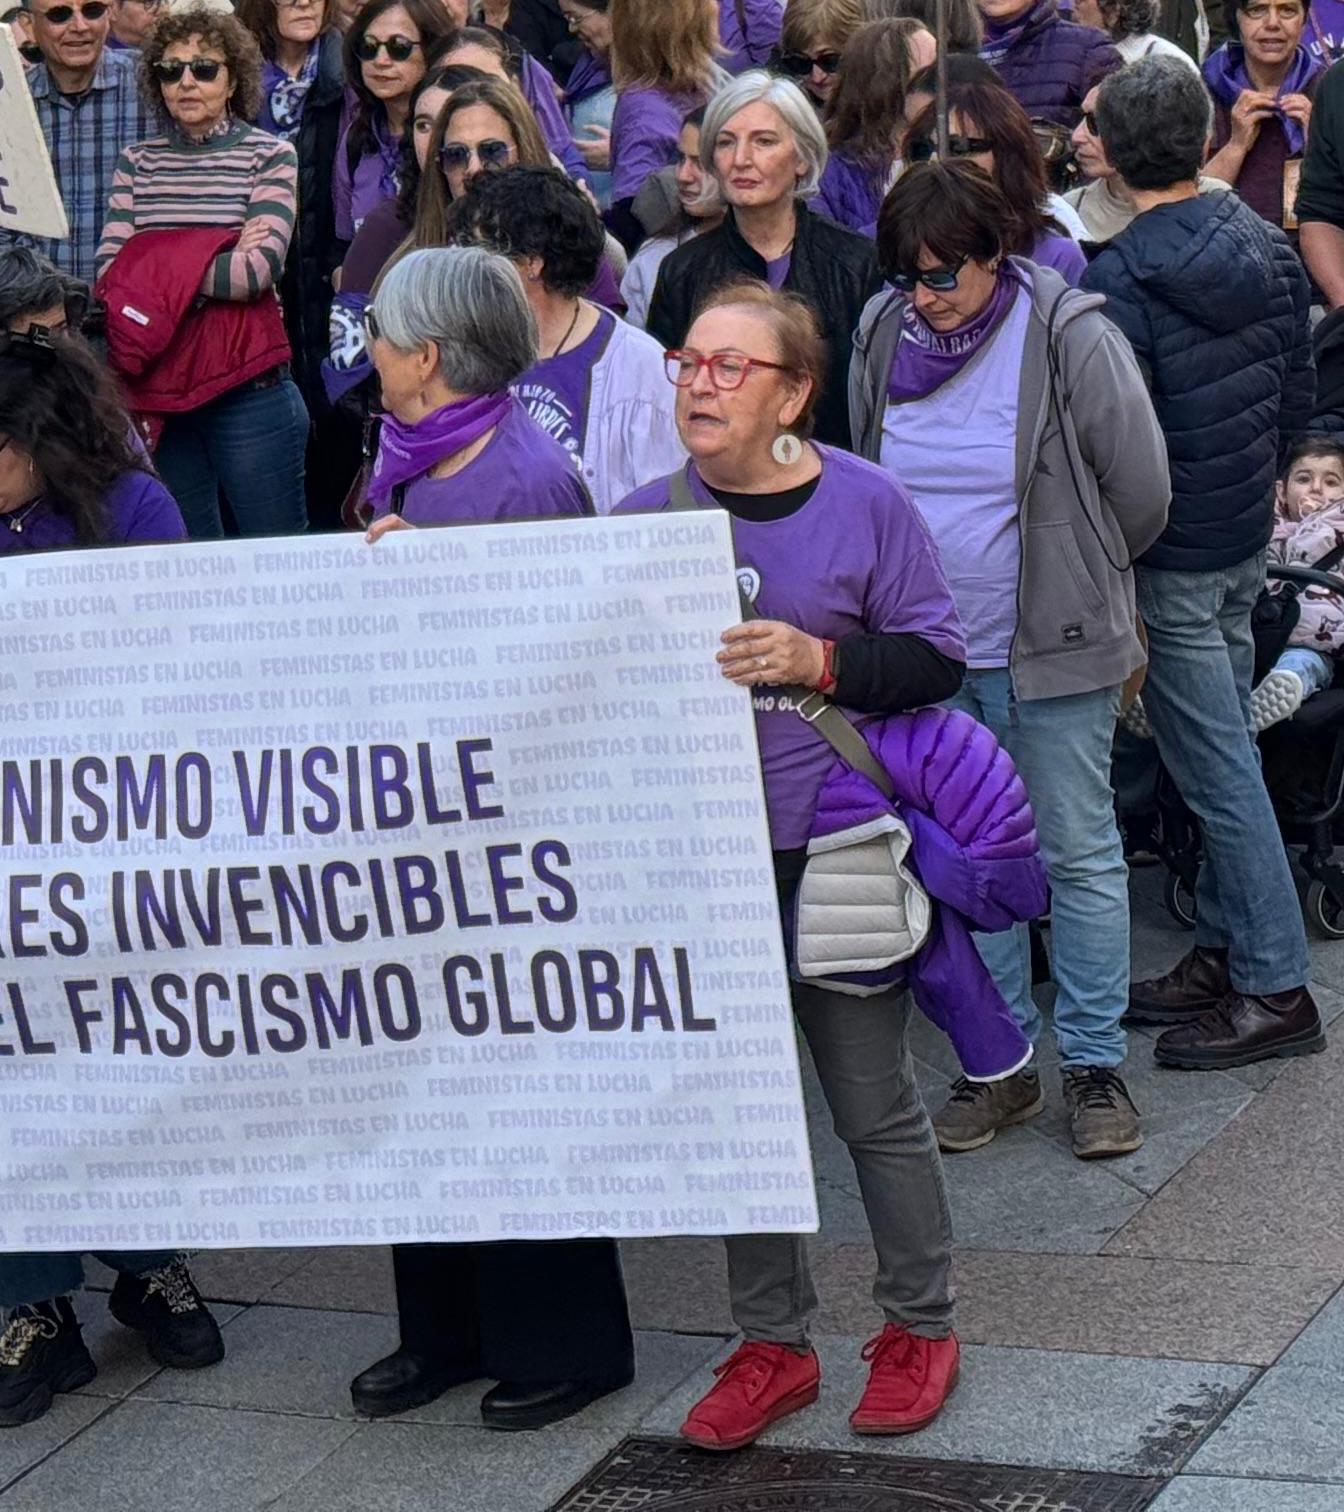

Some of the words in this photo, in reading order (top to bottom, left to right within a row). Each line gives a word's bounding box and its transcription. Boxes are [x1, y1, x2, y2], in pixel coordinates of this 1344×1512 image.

[254, 542, 370, 575] FEMINISTAS
[368, 541, 400, 570] EN
[400, 542, 470, 568] LUCHA
[487, 531, 610, 560] FEMINISTAS
[613, 529, 644, 552] EN
[646, 524, 718, 552] LUCHA
[26, 562, 141, 589] FEMINISTAS
[145, 560, 171, 582] EN
[174, 556, 238, 582] LUCHA
[361, 572, 482, 601] FEMINISTAS
[484, 570, 514, 594] EN
[518, 566, 585, 592] LUCHA
[603, 557, 729, 585] FEMINISTAS
[19, 598, 49, 621] EN
[54, 595, 119, 619] LUCHA
[418, 605, 540, 633] FEMINISTAS
[544, 604, 573, 626] EN
[578, 595, 649, 625] LUCHA
[81, 630, 109, 651] EN
[112, 625, 174, 650] LUCHA
[260, 653, 376, 679] FEMINISTAS
[380, 650, 409, 673] EN
[413, 647, 479, 671] LUCHA
[508, 736, 638, 768] FEMINISTAS
[642, 735, 671, 757] EN
[675, 733, 745, 758] LUCHA
[232, 738, 505, 837] VISIBLE
[112, 839, 579, 954] INVENCIBLES
[65, 962, 422, 1060] FASCISMO
[442, 946, 718, 1037] GLOBAL
[304, 1043, 433, 1078] FEMINISTAS
[437, 1046, 467, 1067] EN
[471, 1039, 539, 1067] LUCHA
[554, 1040, 678, 1063] FEMINISTAS
[682, 1040, 712, 1062] EN
[712, 1033, 785, 1061] LUCHA
[428, 1074, 550, 1099] FEMINISTAS
[554, 1074, 583, 1095] EN
[588, 1069, 653, 1096] LUCHA
[488, 1107, 610, 1131] FEMINISTAS
[613, 1107, 643, 1130] EN
[646, 1106, 716, 1130] LUCHA
[500, 1205, 623, 1229] FEMINISTAS
[625, 1210, 656, 1228] EN
[660, 1208, 728, 1228] LUCHA
